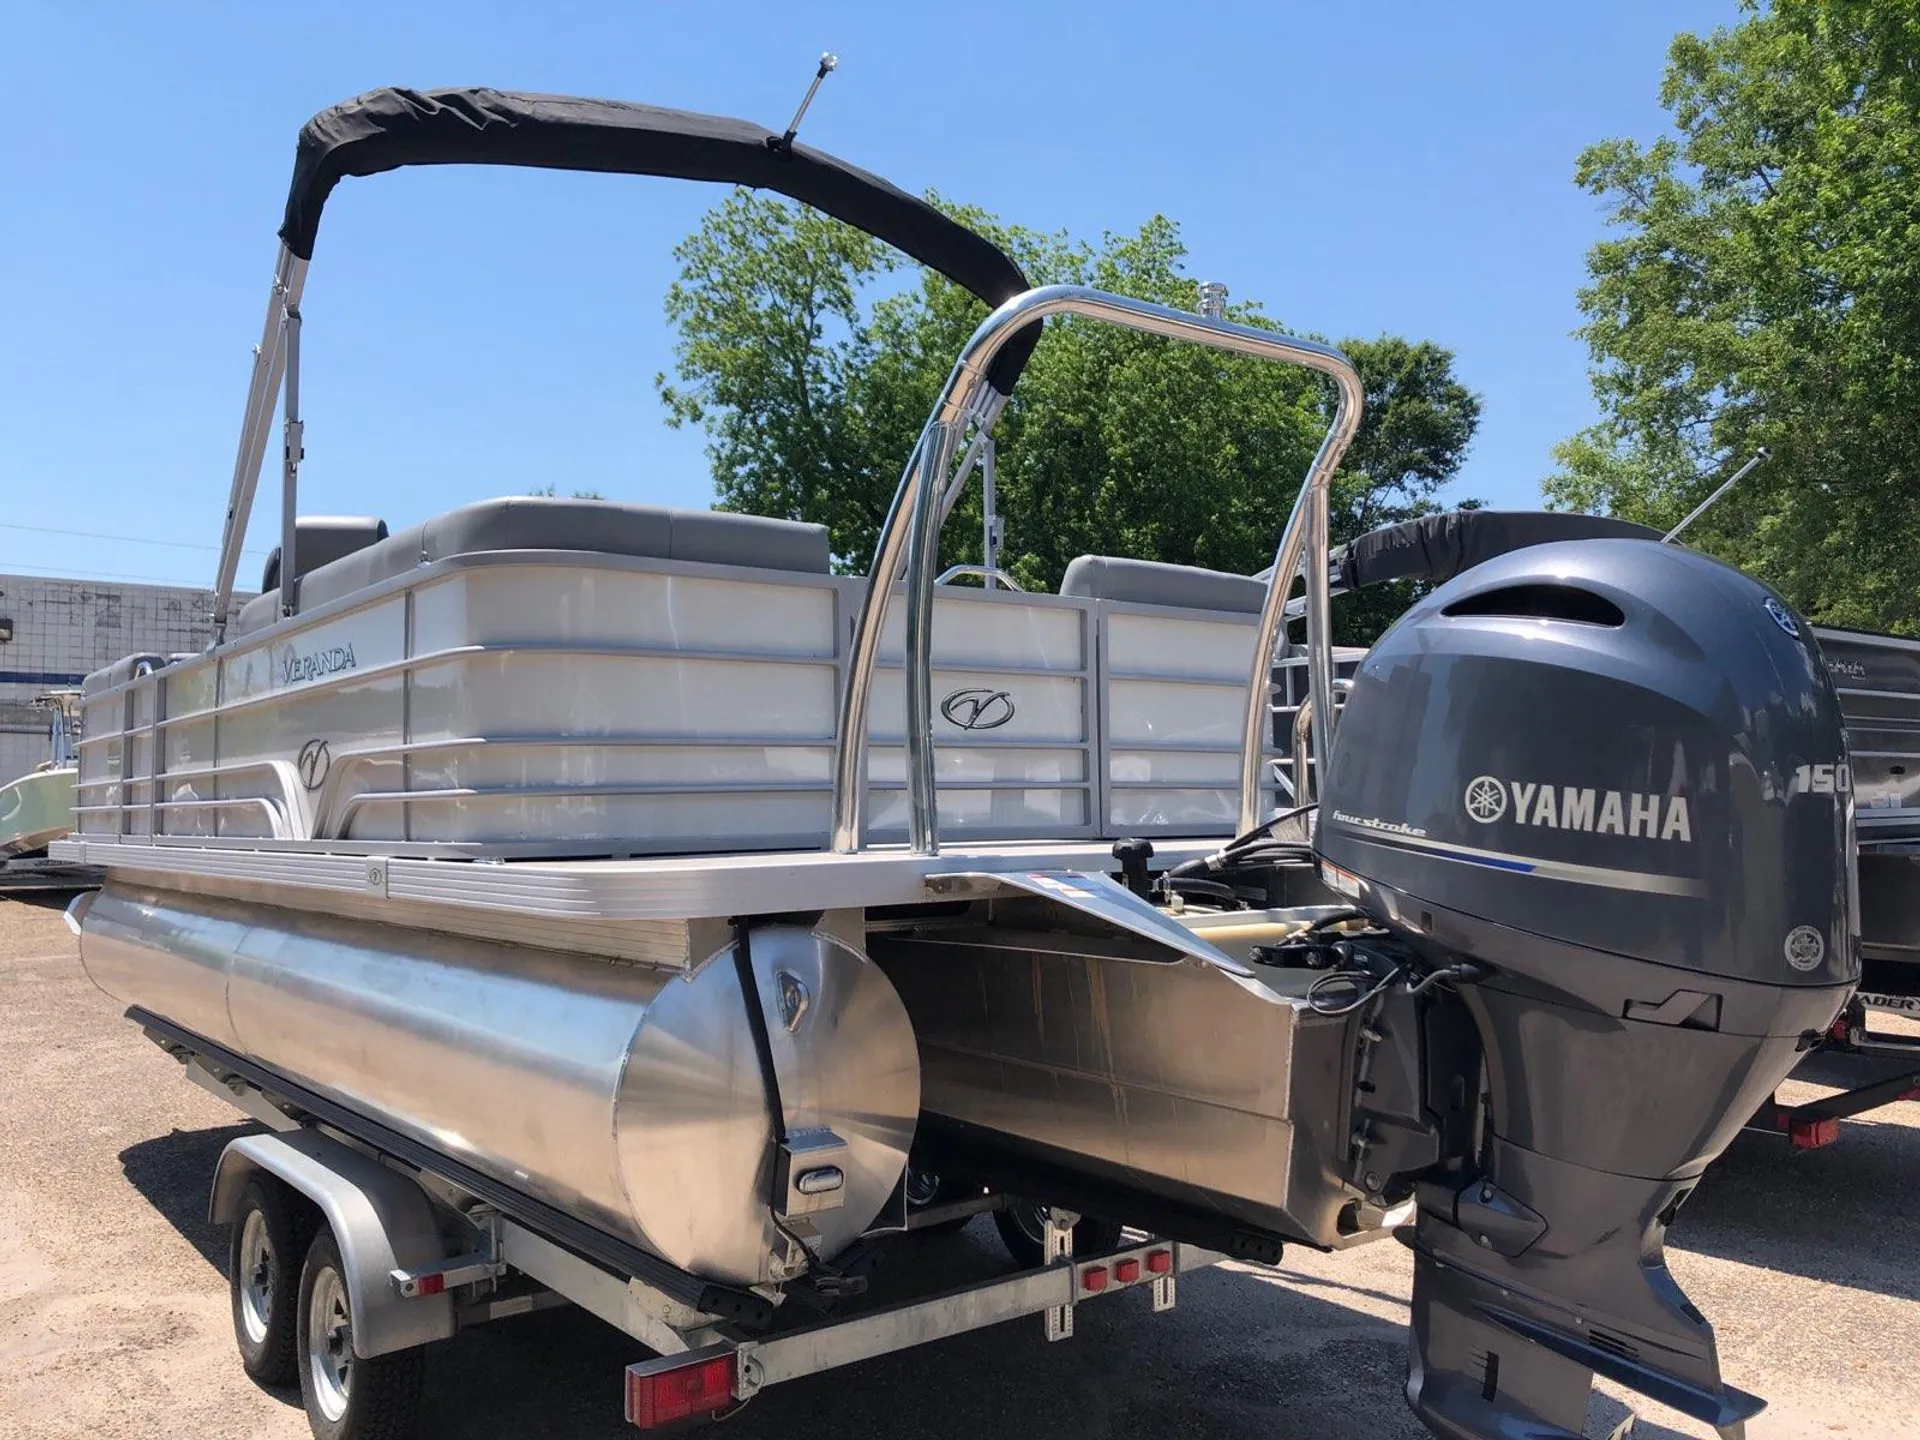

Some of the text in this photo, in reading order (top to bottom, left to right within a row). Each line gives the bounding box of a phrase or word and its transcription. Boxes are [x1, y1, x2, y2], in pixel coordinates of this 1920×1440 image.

[284, 642, 356, 683] VERANDA
[1796, 764, 1850, 793] 150
[1511, 782, 1691, 842] YAMAHA
